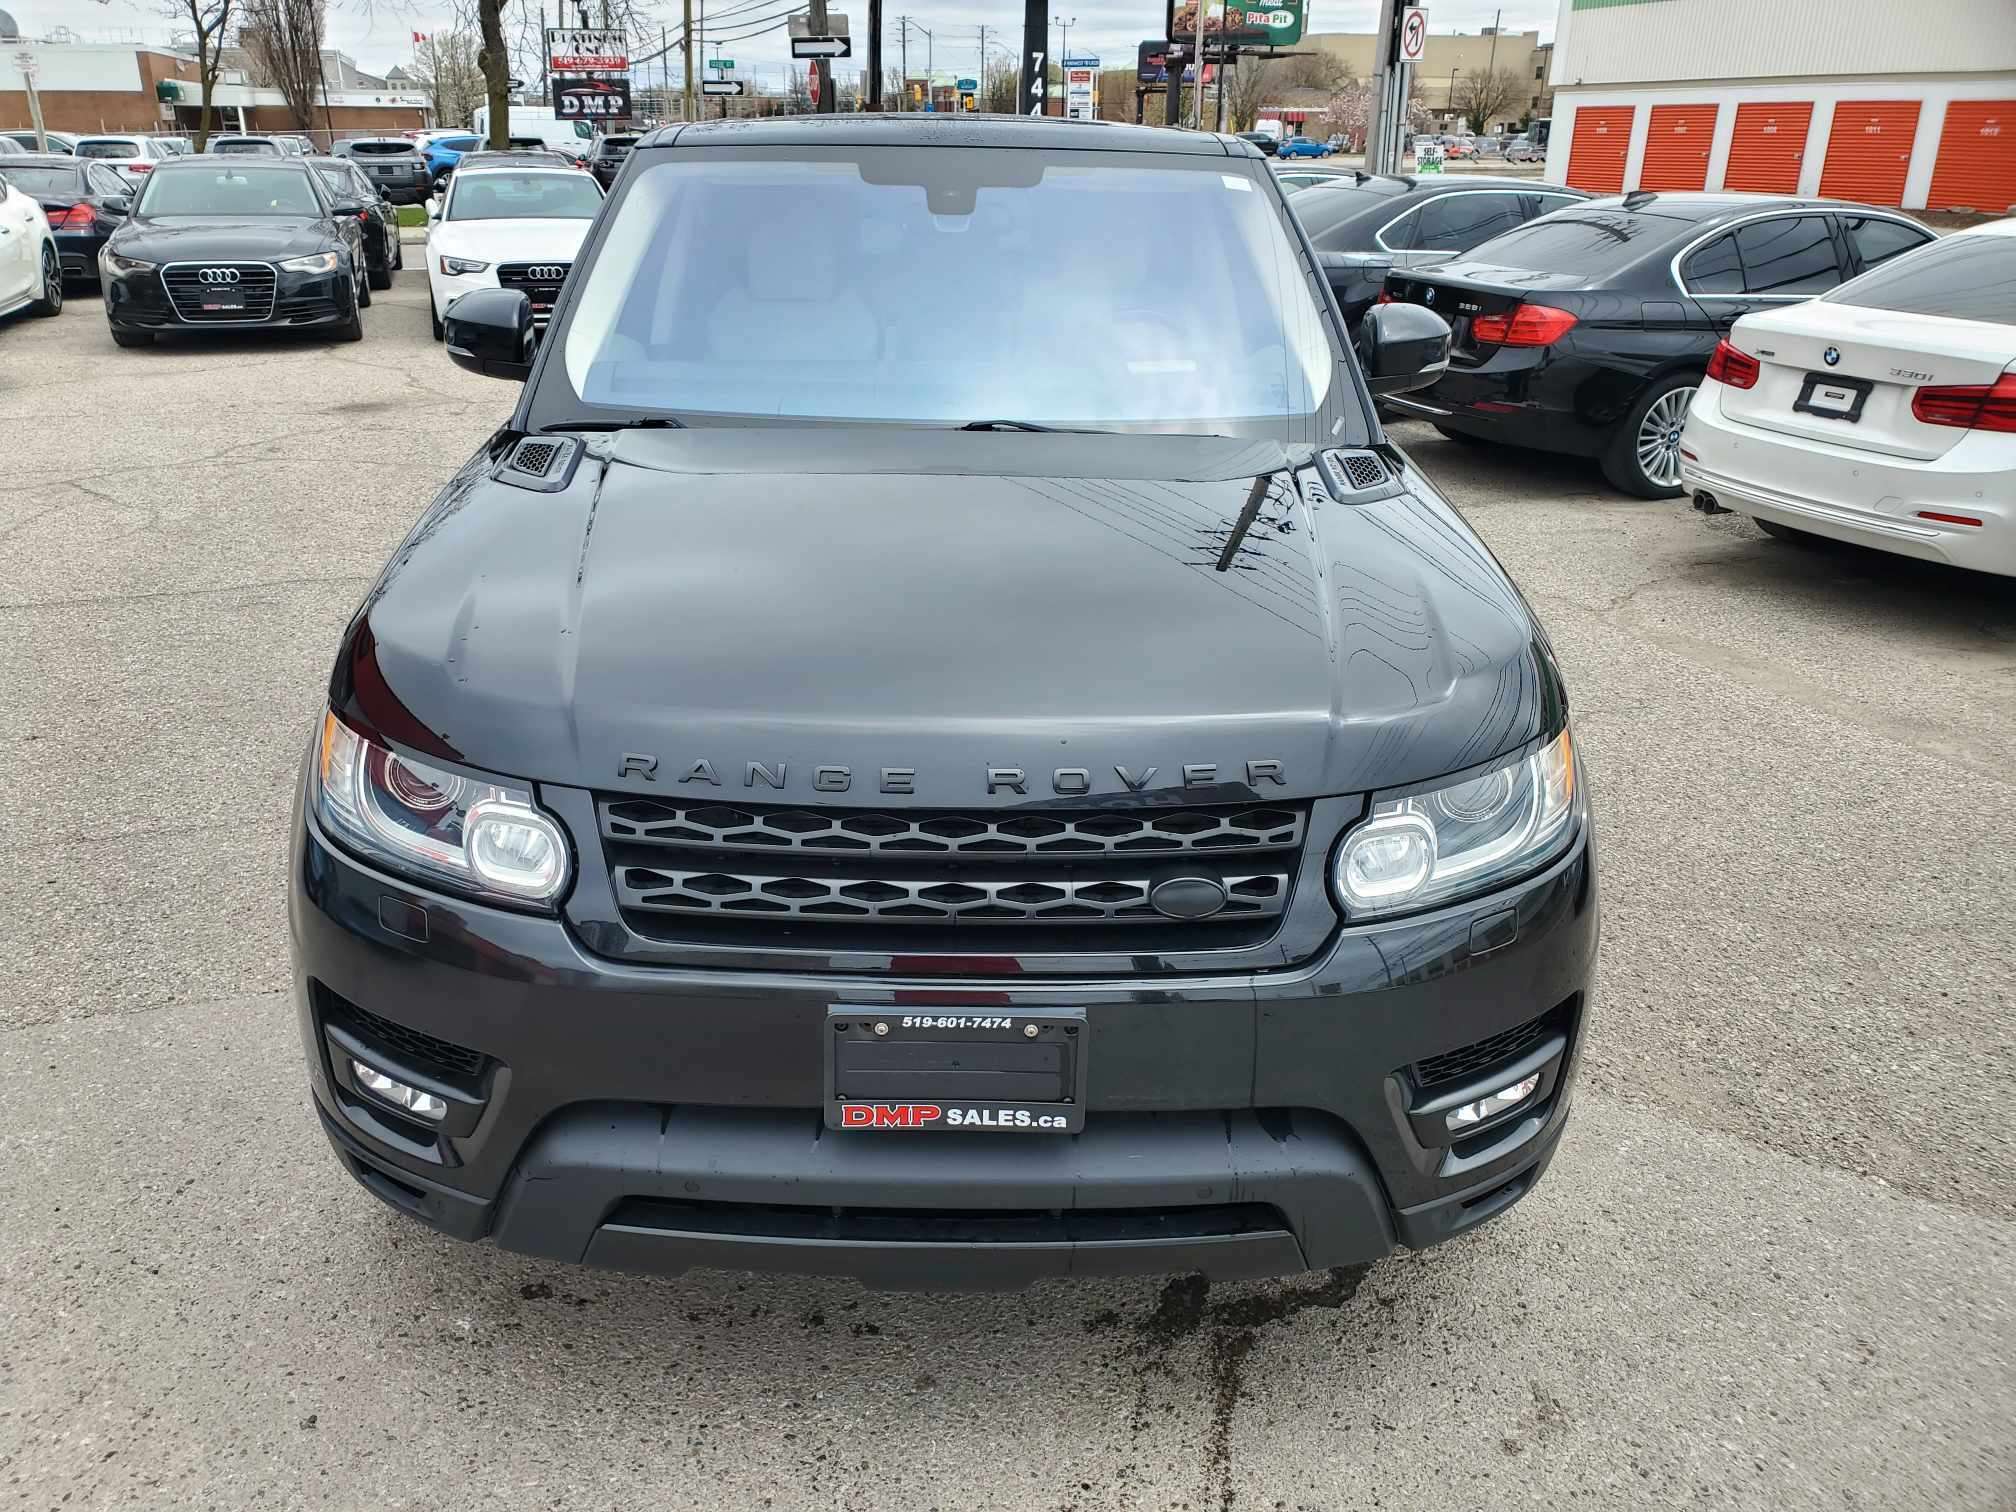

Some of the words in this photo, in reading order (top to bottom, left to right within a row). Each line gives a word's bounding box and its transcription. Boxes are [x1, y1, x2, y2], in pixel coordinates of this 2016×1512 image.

[1246, 12, 1270, 24] Pita
[1272, 14, 1288, 24] Pit
[561, 95, 624, 113] DMP
[617, 752, 915, 794] RANGE
[986, 758, 1287, 795] ROVER
[902, 1016, 1012, 1028] 519-601-7474
[841, 1104, 942, 1128] DMP
[946, 1108, 1067, 1128] SALES.ca
